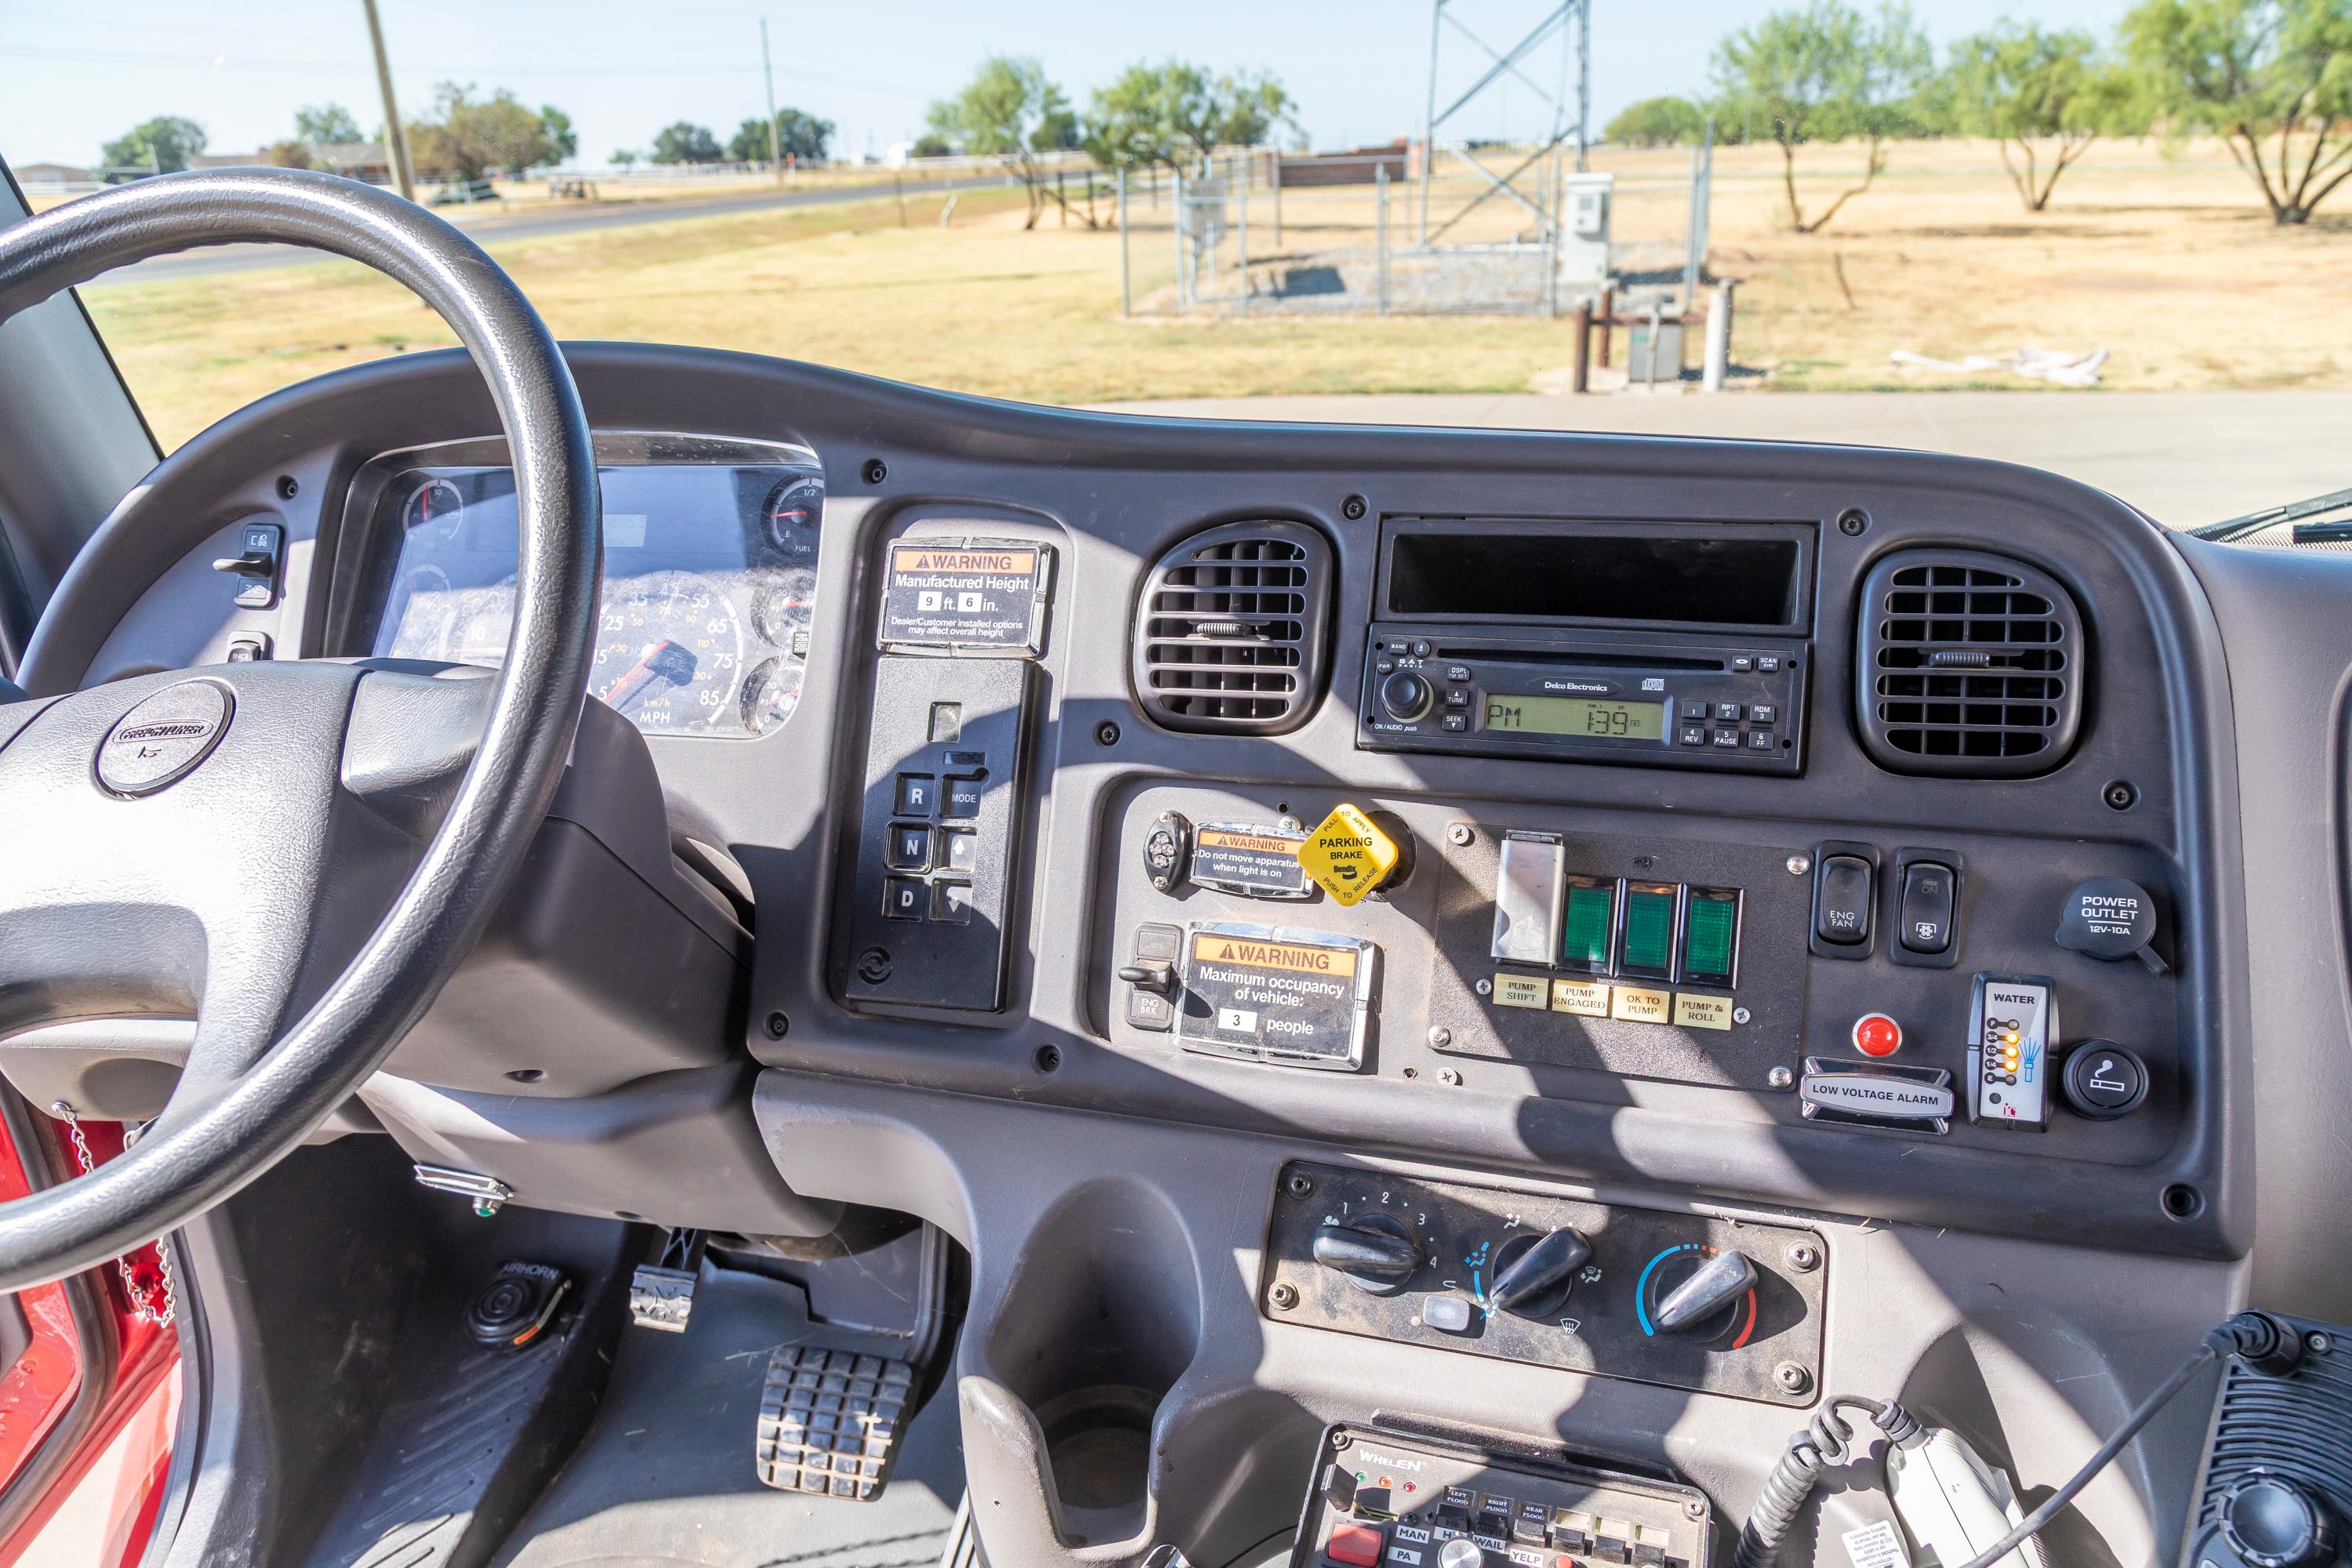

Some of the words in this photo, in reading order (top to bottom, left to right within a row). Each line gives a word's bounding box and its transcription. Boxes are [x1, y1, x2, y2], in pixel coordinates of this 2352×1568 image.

[932, 554, 1012, 571] WARNING
[895, 573, 984, 589] Manufactured
[985, 576, 1029, 593] Height
[628, 591, 648, 607] 35
[690, 593, 710, 609] 55
[925, 597, 933, 606] 9
[943, 597, 956, 611] ft.
[965, 598, 974, 607] 6
[982, 600, 999, 612] in.
[604, 615, 624, 631] 25
[632, 618, 644, 627] 50
[685, 614, 697, 625] 90
[891, 616, 956, 627] Dealer/Customer
[958, 619, 992, 629] installed
[993, 619, 1023, 630] options
[707, 618, 728, 634] 65
[908, 627, 924, 636] may
[924, 626, 949, 635] affect
[950, 627, 977, 637] overall
[978, 628, 1004, 638] height
[616, 644, 627, 653] 30
[593, 648, 608, 665] 15
[713, 653, 734, 670] 75
[1544, 681, 1566, 690] Delco
[1566, 682, 1608, 691] Electronics
[598, 685, 608, 701] 5
[699, 690, 720, 706] 85
[643, 697, 671, 708] km/h
[639, 711, 671, 723] MPH
[1487, 704, 1521, 728] PM
[911, 788, 923, 804] R
[951, 793, 977, 804] MODE
[1323, 818, 1338, 833] PULL
[1352, 817, 1371, 833] APPLY
[906, 840, 919, 856] N
[1229, 837, 1286, 852] WARNING
[1319, 837, 1373, 848] PARKING
[1198, 849, 1210, 859] Do
[1212, 851, 1228, 861] not
[1229, 854, 1254, 866] move
[1255, 855, 1300, 870] apparatus
[1330, 851, 1363, 860] BRAKE
[1213, 862, 1237, 875] when
[1239, 864, 1258, 878] light
[1260, 866, 1269, 877] is
[1269, 869, 1283, 879] on
[1334, 865, 1356, 873] Bendix
[1323, 877, 1340, 893] PUSH
[1353, 866, 1378, 893] RELEASE
[1921, 885, 1939, 895] ON
[901, 891, 913, 907] D
[2082, 896, 2138, 908] POWER
[1830, 909, 1855, 921] ENG
[2082, 908, 2139, 920] OUTLET
[1831, 918, 1853, 929] FAN
[2089, 925, 2131, 935] 12V-10A
[1238, 945, 1330, 970] WARNING
[1200, 966, 1265, 987] Maximum
[1269, 977, 1345, 999] occupancy
[1508, 982, 1537, 992] PUMP
[1235, 988, 1251, 1000] of
[1251, 989, 1304, 1007] vehicle:
[1506, 991, 1537, 1002] SHIFT
[1565, 988, 1595, 998] PUMP
[1994, 993, 2035, 1004] WATER
[1141, 997, 1160, 1007] ENG
[1553, 996, 1606, 1010] ENGAGED
[1626, 995, 1642, 1004] OK
[1645, 996, 1661, 1005] TO
[1140, 1006, 1157, 1015] BRK
[1628, 1005, 1657, 1015] PUMP
[1682, 1000, 1713, 1011] PUMP
[1715, 1004, 1723, 1013] &
[1687, 1011, 1717, 1022] ROLL
[1232, 1014, 1241, 1026] 3
[1266, 1018, 1314, 1036] people
[1813, 1084, 1839, 1096] LOW
[1842, 1087, 1894, 1102] VOLTAGE
[1896, 1093, 1939, 1106] ALARM
[1381, 1192, 1389, 1204] 2
[1342, 1202, 1348, 1214] 1
[1417, 1213, 1425, 1225] 3
[1429, 1256, 1437, 1269] 4
[1359, 1450, 1422, 1472] WHELEN
[1447, 1497, 1468, 1505] FLOOD
[1488, 1498, 1507, 1507] RIGHT
[1523, 1512, 1544, 1520] FLOOD
[1399, 1528, 1427, 1541] MAN
[1474, 1537, 1503, 1551] WAIL
[1397, 1550, 1411, 1561] PA
[1512, 1552, 1541, 1565] YELP
